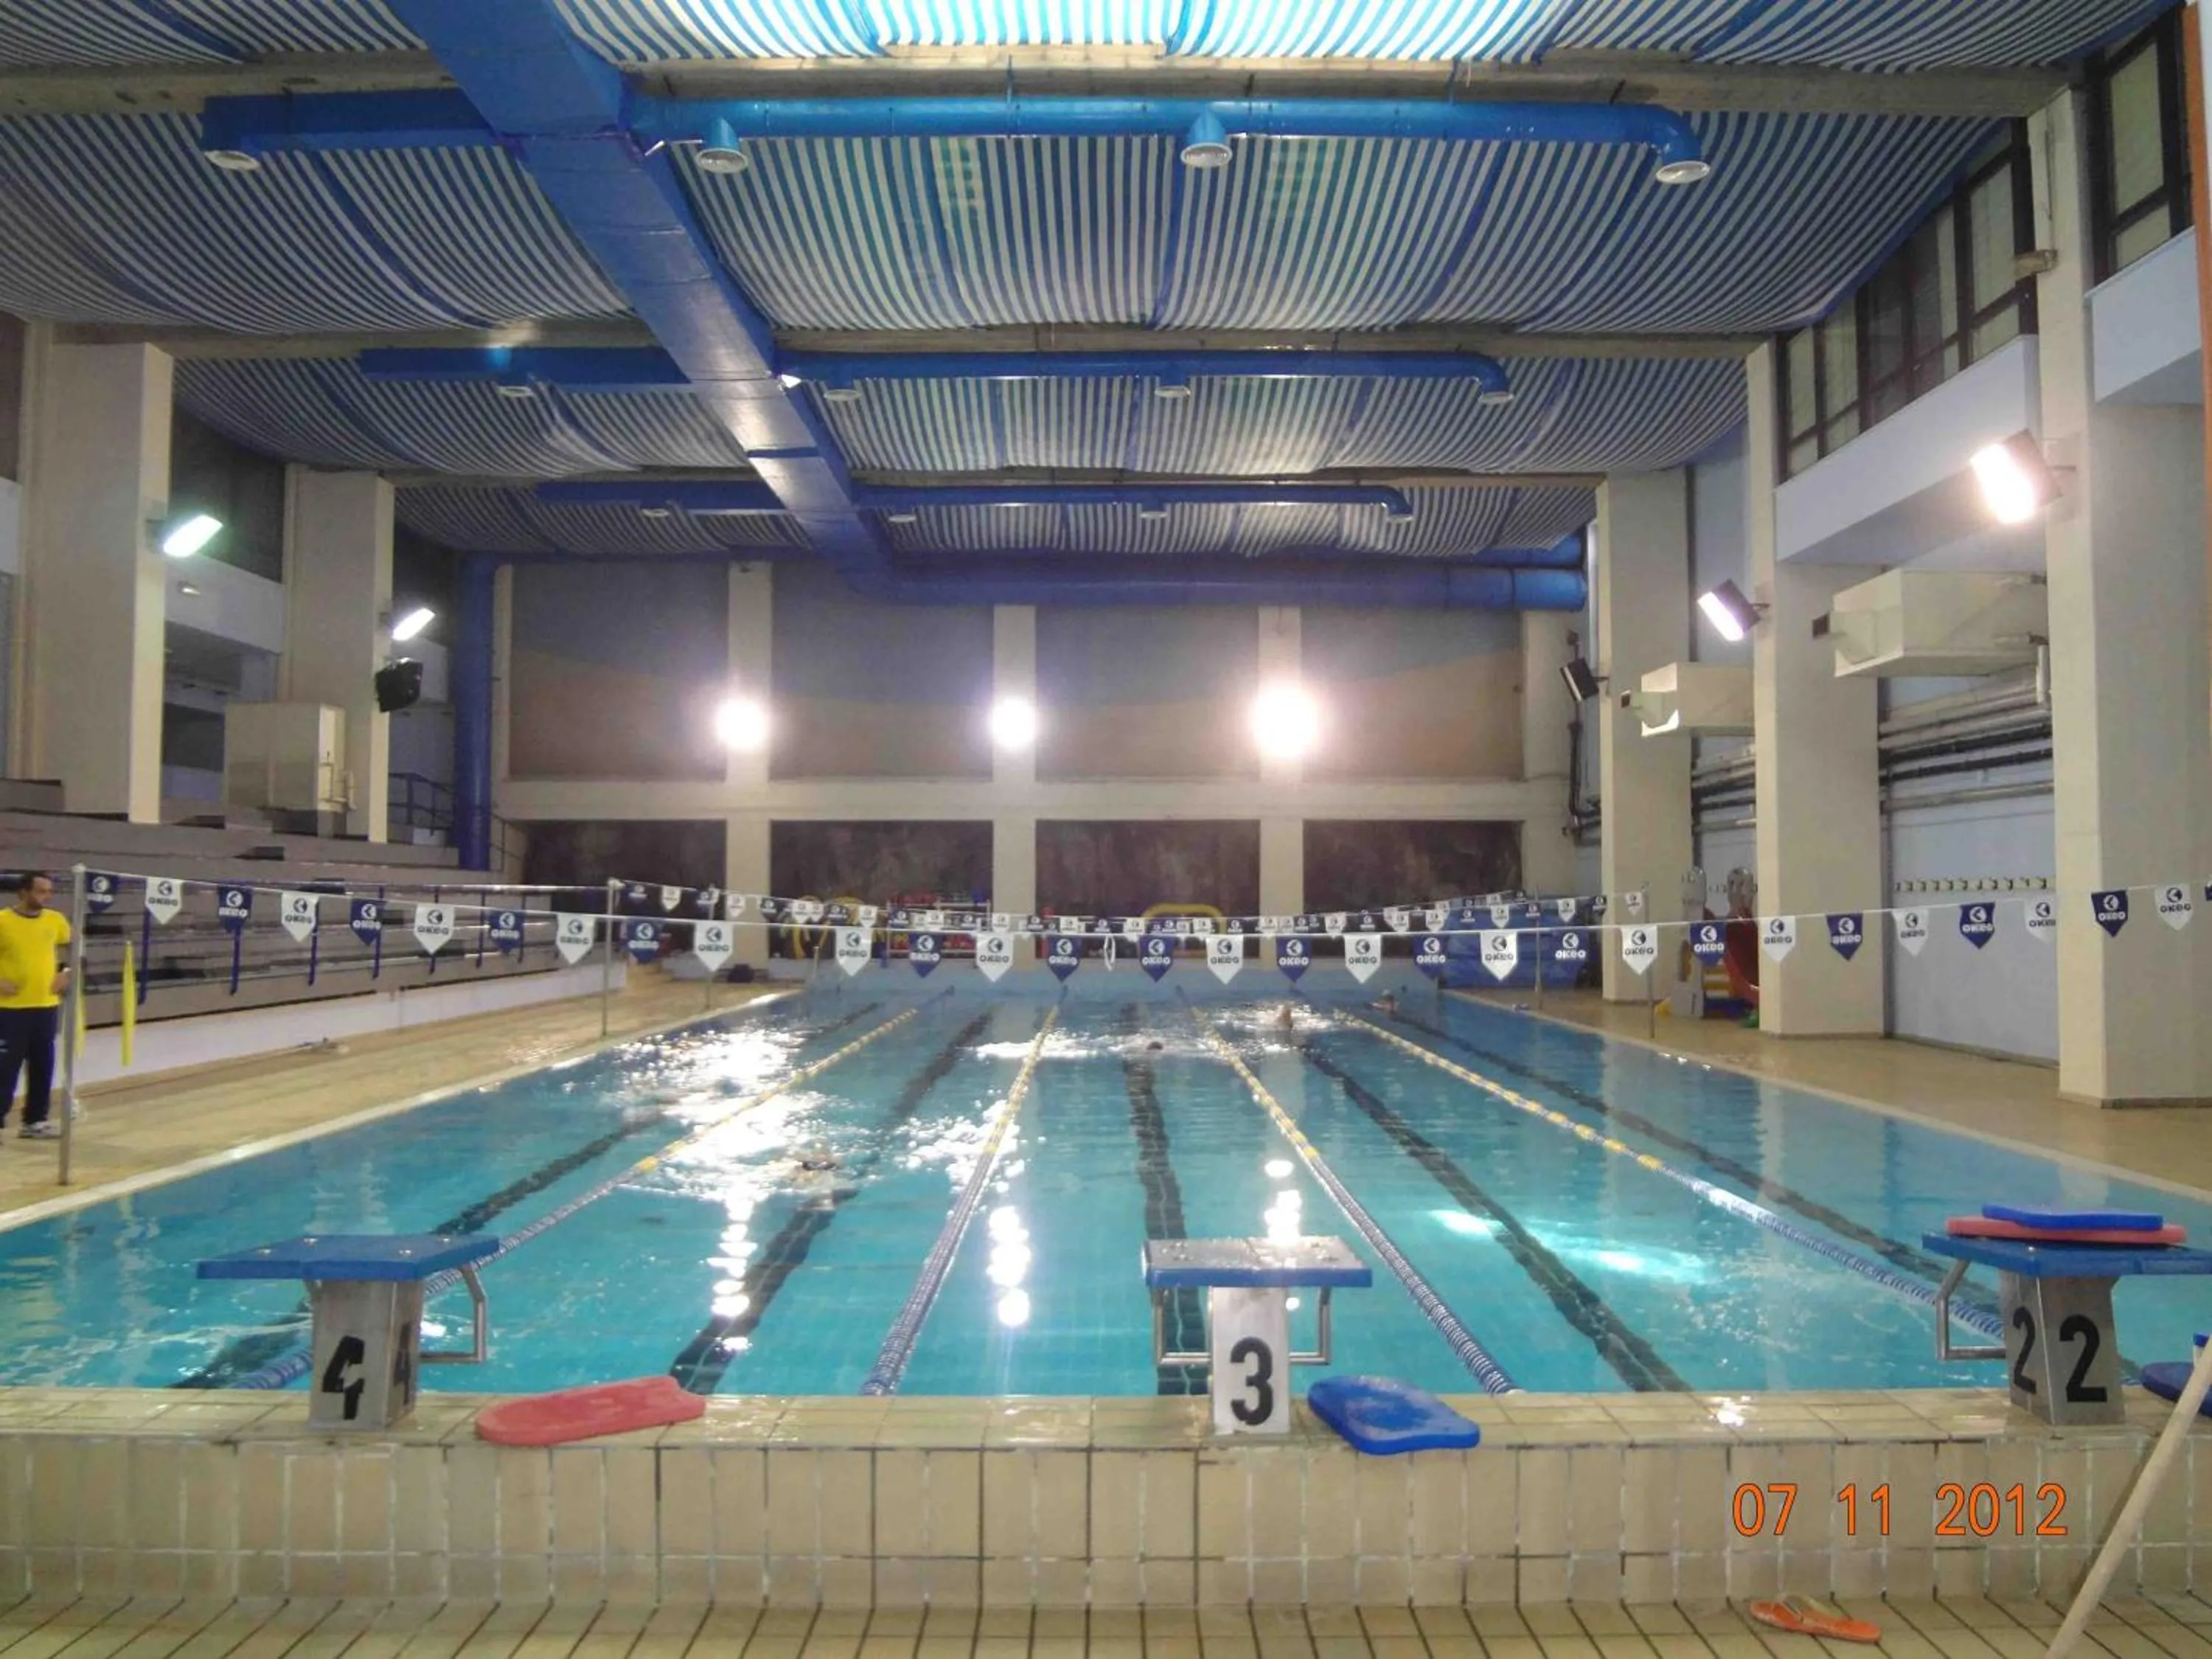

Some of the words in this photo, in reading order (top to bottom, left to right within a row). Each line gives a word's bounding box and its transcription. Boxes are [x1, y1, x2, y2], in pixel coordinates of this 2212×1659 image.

[322, 1335, 366, 1420] 4
[1230, 1337, 1273, 1426] 3
[2013, 1306, 2037, 1395] 2
[2059, 1314, 2108, 1403] 2
